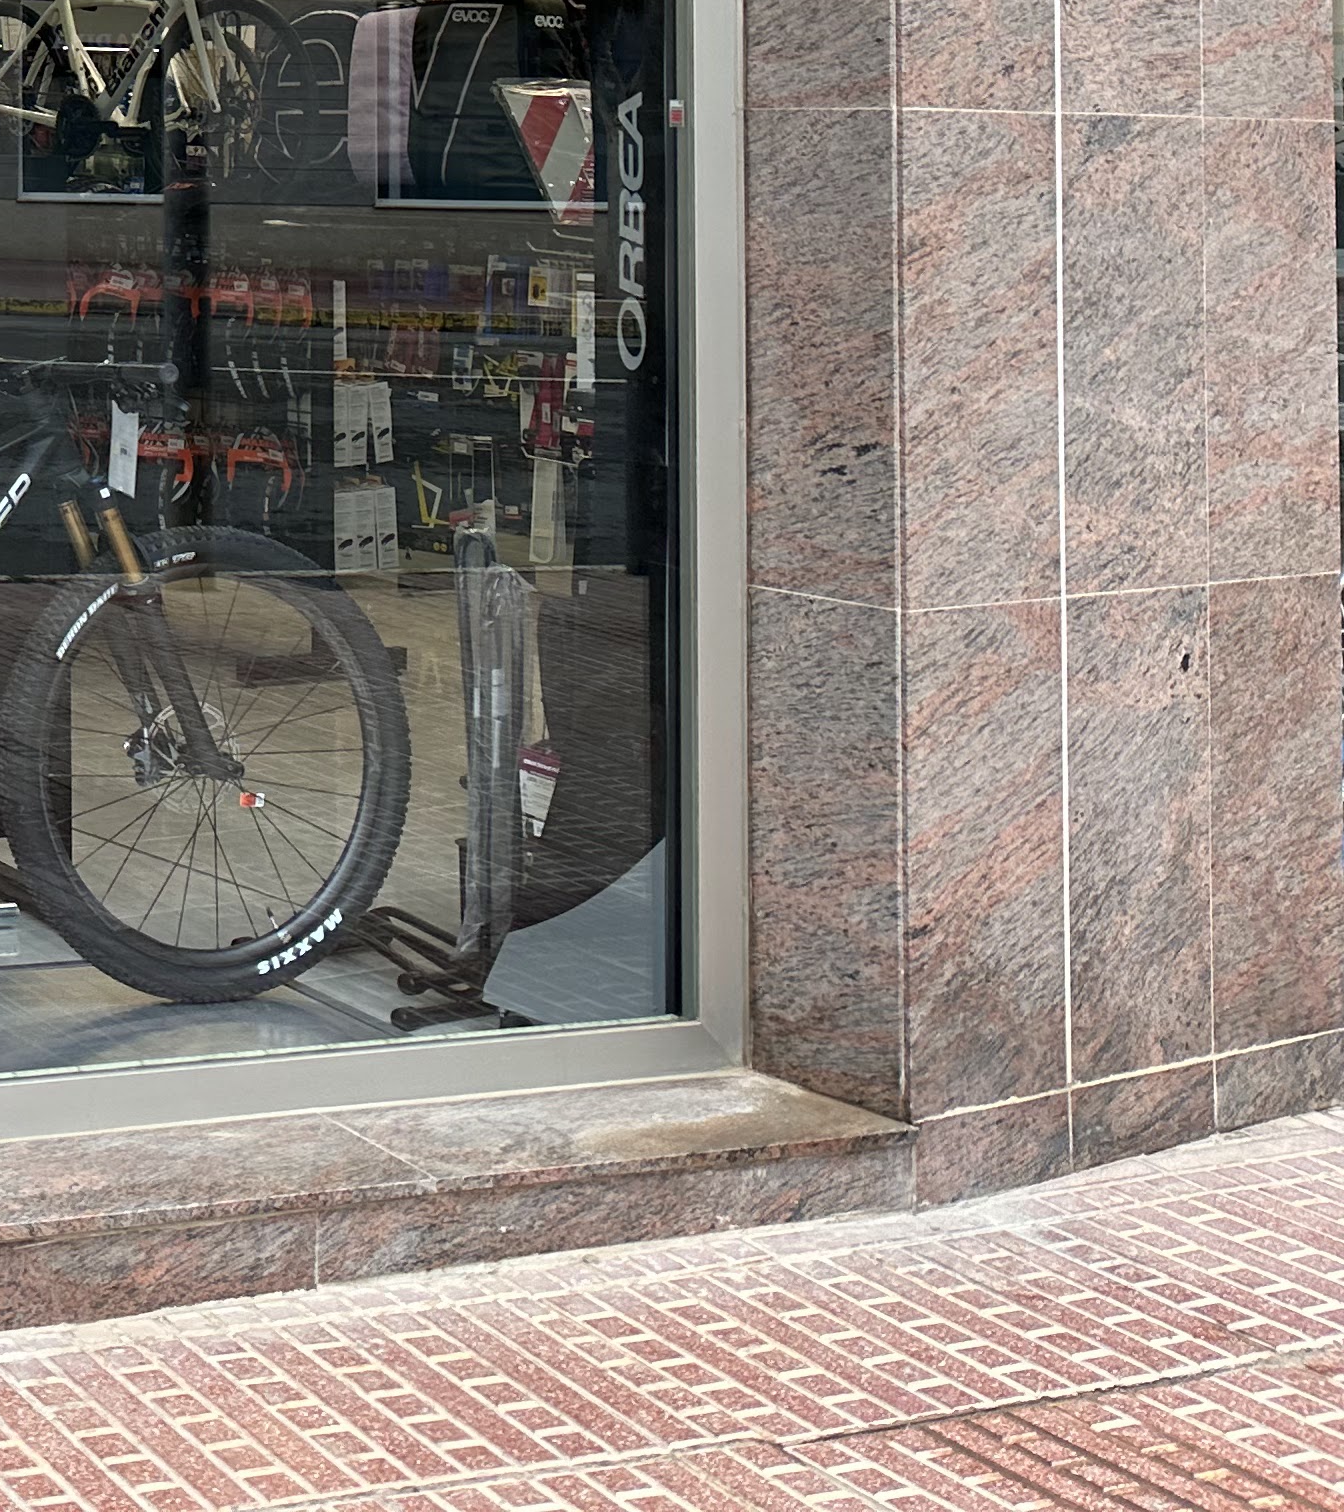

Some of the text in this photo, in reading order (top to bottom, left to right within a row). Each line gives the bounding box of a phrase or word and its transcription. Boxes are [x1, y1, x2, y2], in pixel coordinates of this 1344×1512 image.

[452, 9, 490, 24] evoc
[535, 14, 564, 29] evoc
[617, 91, 647, 371] ORBEA
[257, 908, 343, 975] MAXXIS
